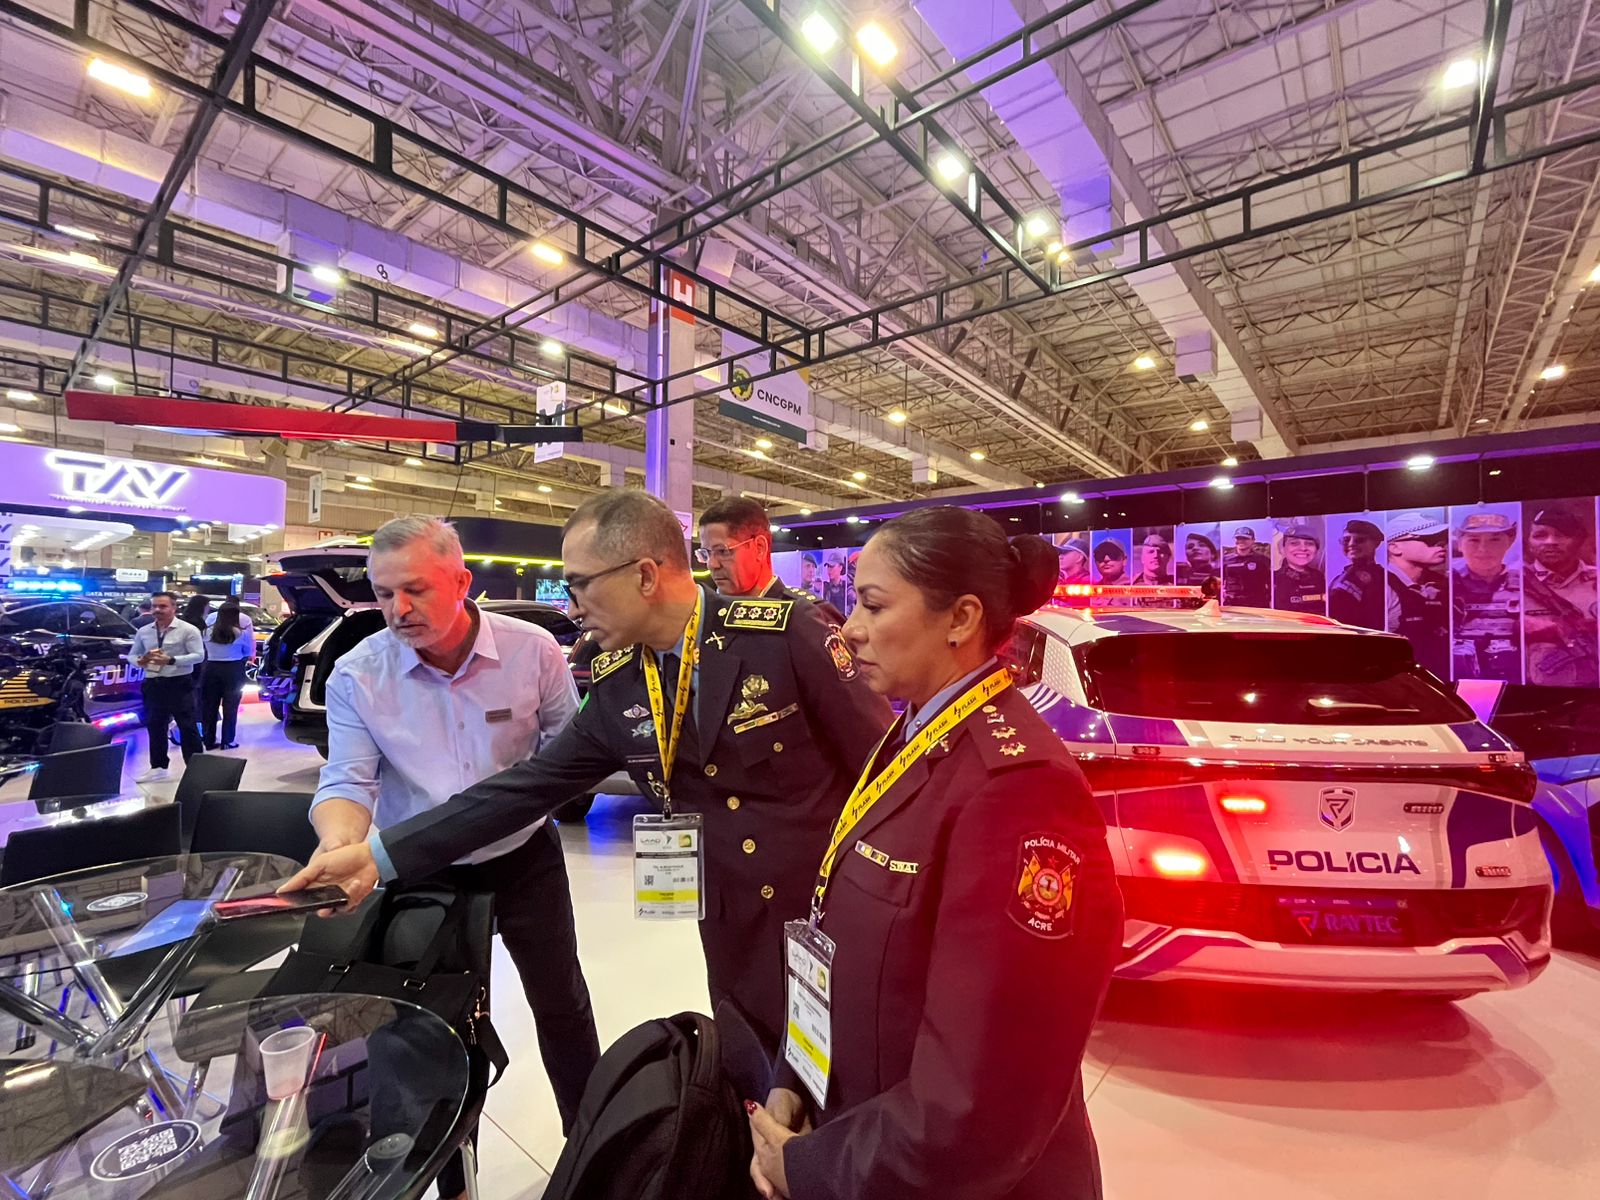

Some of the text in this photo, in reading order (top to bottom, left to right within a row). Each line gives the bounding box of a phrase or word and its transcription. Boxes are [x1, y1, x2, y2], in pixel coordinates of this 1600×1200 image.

[757, 389, 802, 416] CNCGPM
[54, 456, 188, 499] TAV
[961, 696, 977, 711] FLASH
[932, 719, 948, 734] FLASH
[906, 744, 920, 760] FLASH
[882, 770, 895, 787] FLASH
[857, 796, 871, 812] FLASH
[1024, 836, 1080, 865] POLÍCIA MILITAR
[1028, 917, 1053, 931] ACRE
[1324, 914, 1401, 933] RAYTEC
